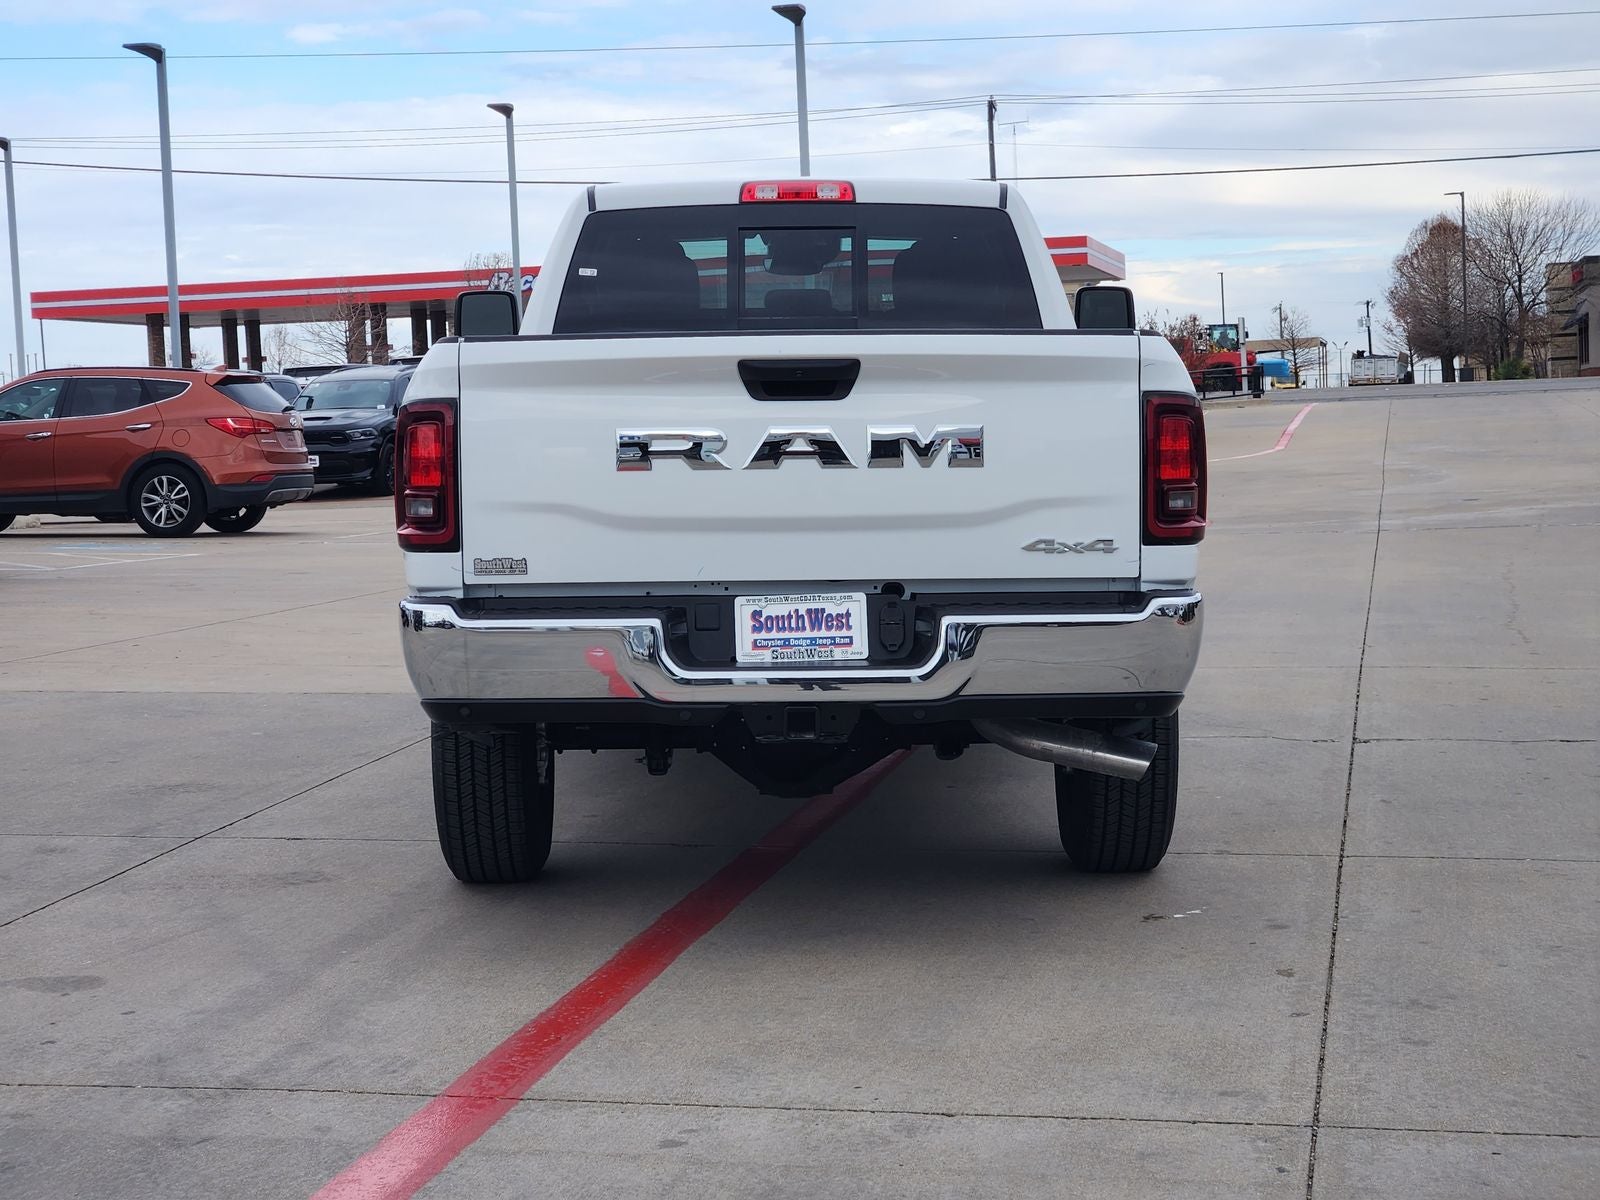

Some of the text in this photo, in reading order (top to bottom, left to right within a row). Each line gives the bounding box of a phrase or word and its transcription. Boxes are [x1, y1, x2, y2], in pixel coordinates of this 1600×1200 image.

[615, 424, 985, 471] RAM
[1021, 539, 1119, 554] 4x4
[474, 558, 527, 569] SouthWest
[750, 607, 853, 635] SouthWest
[756, 636, 850, 647] Chrysler Dodge Jeep Ram
[771, 647, 836, 660] SouthWest
